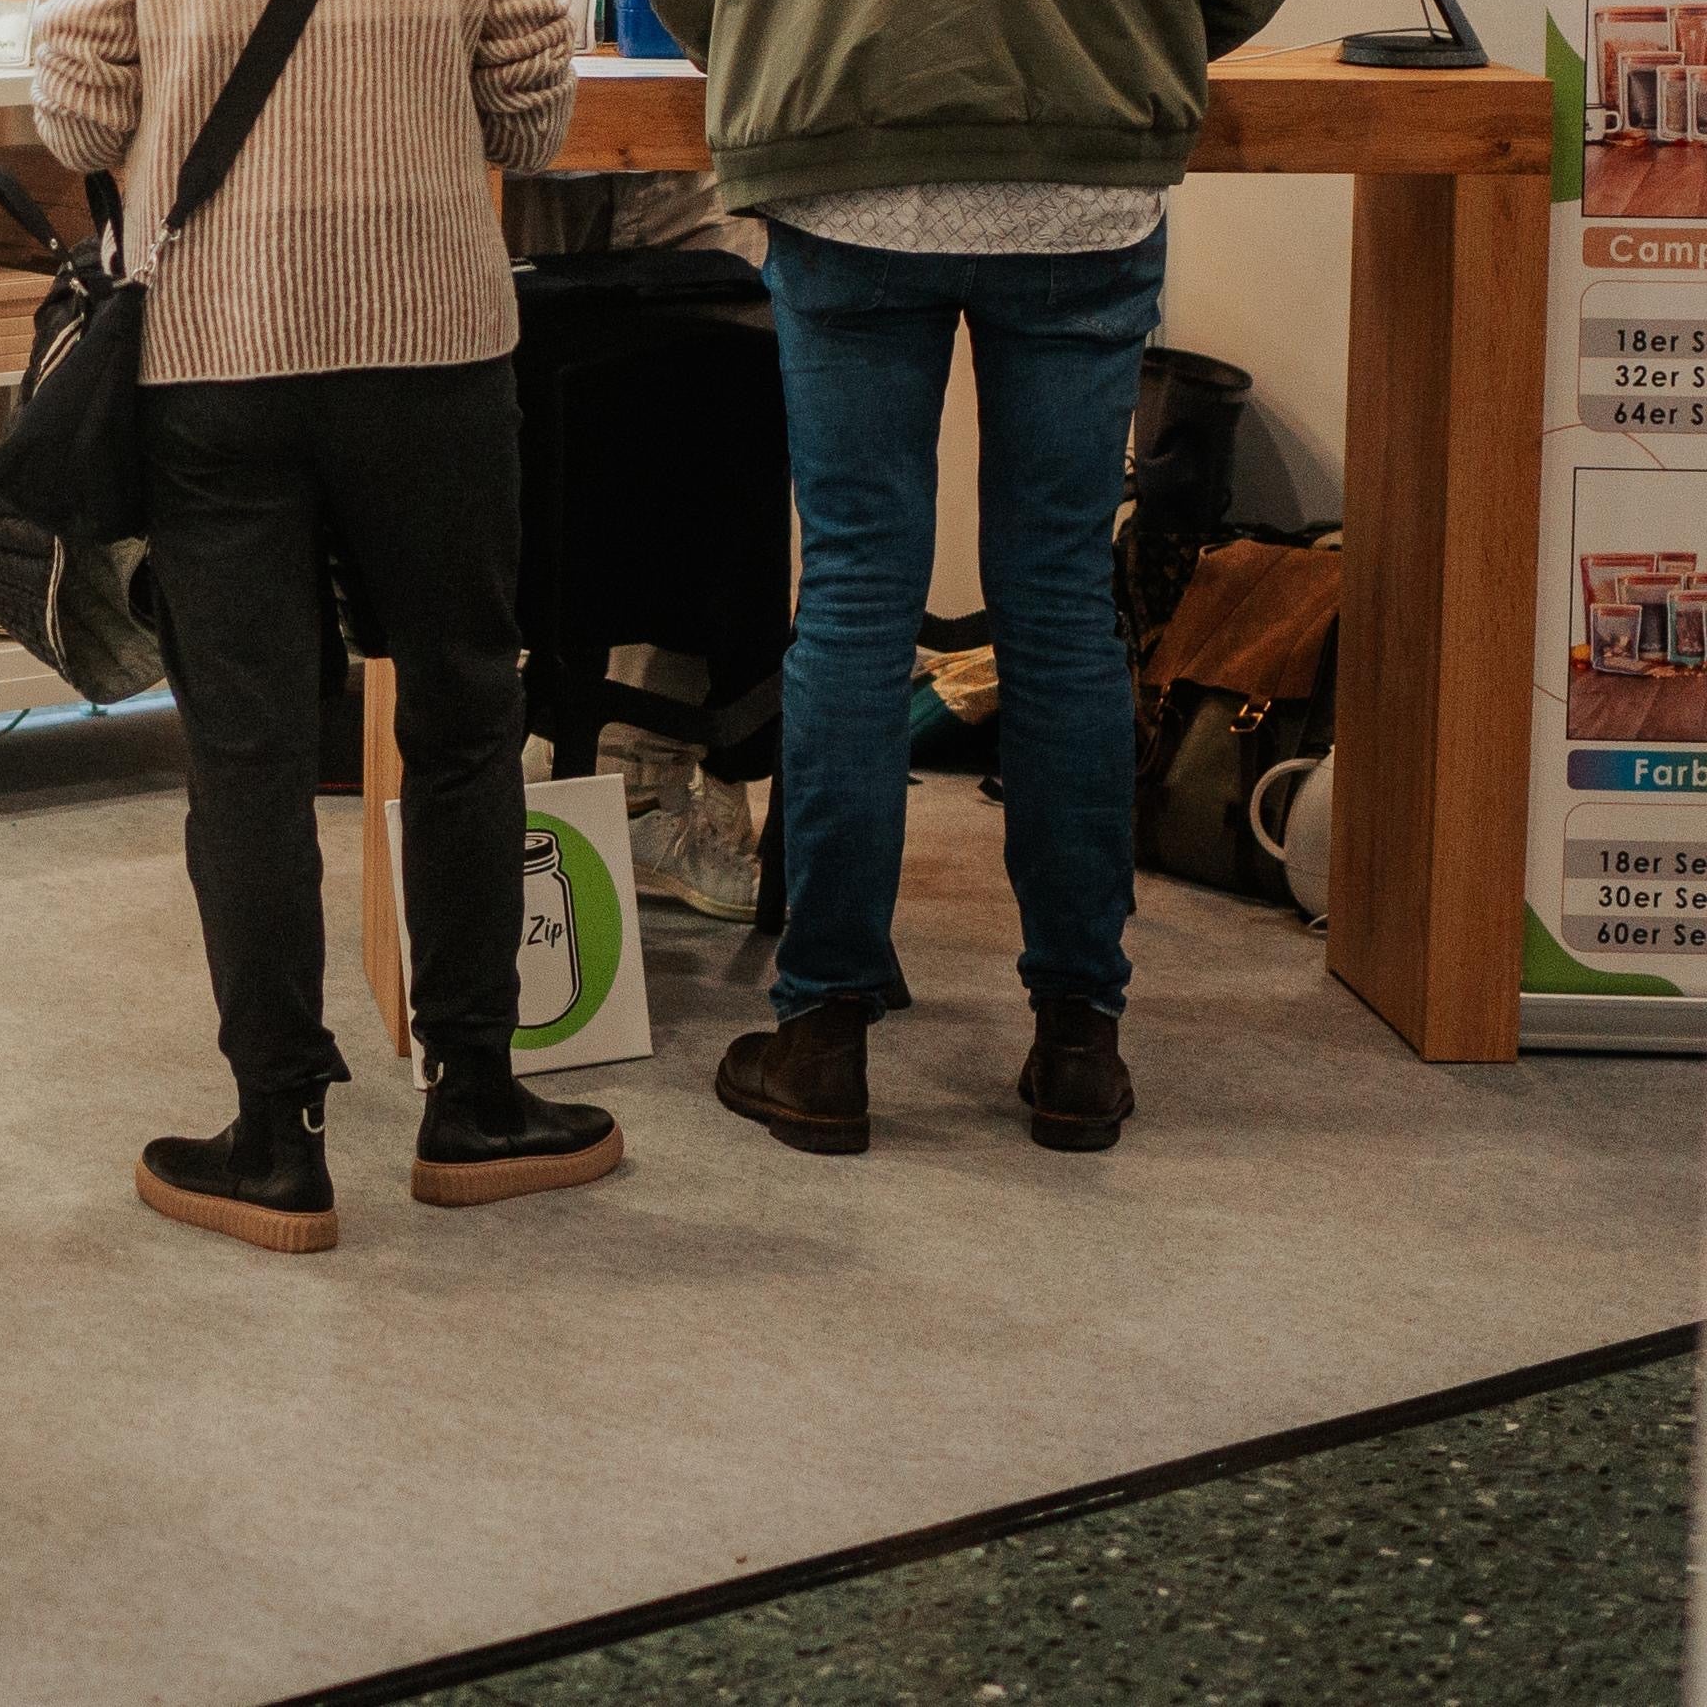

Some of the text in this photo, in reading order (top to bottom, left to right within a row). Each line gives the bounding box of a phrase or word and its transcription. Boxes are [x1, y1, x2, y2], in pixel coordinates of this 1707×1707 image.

[1616, 329, 1679, 353] 18er
[1615, 364, 1680, 387] 32er
[1614, 401, 1678, 425] 64er
[1599, 850, 1663, 874] 18er
[1598, 885, 1662, 908] 30er
[1597, 921, 1661, 945] 60er
